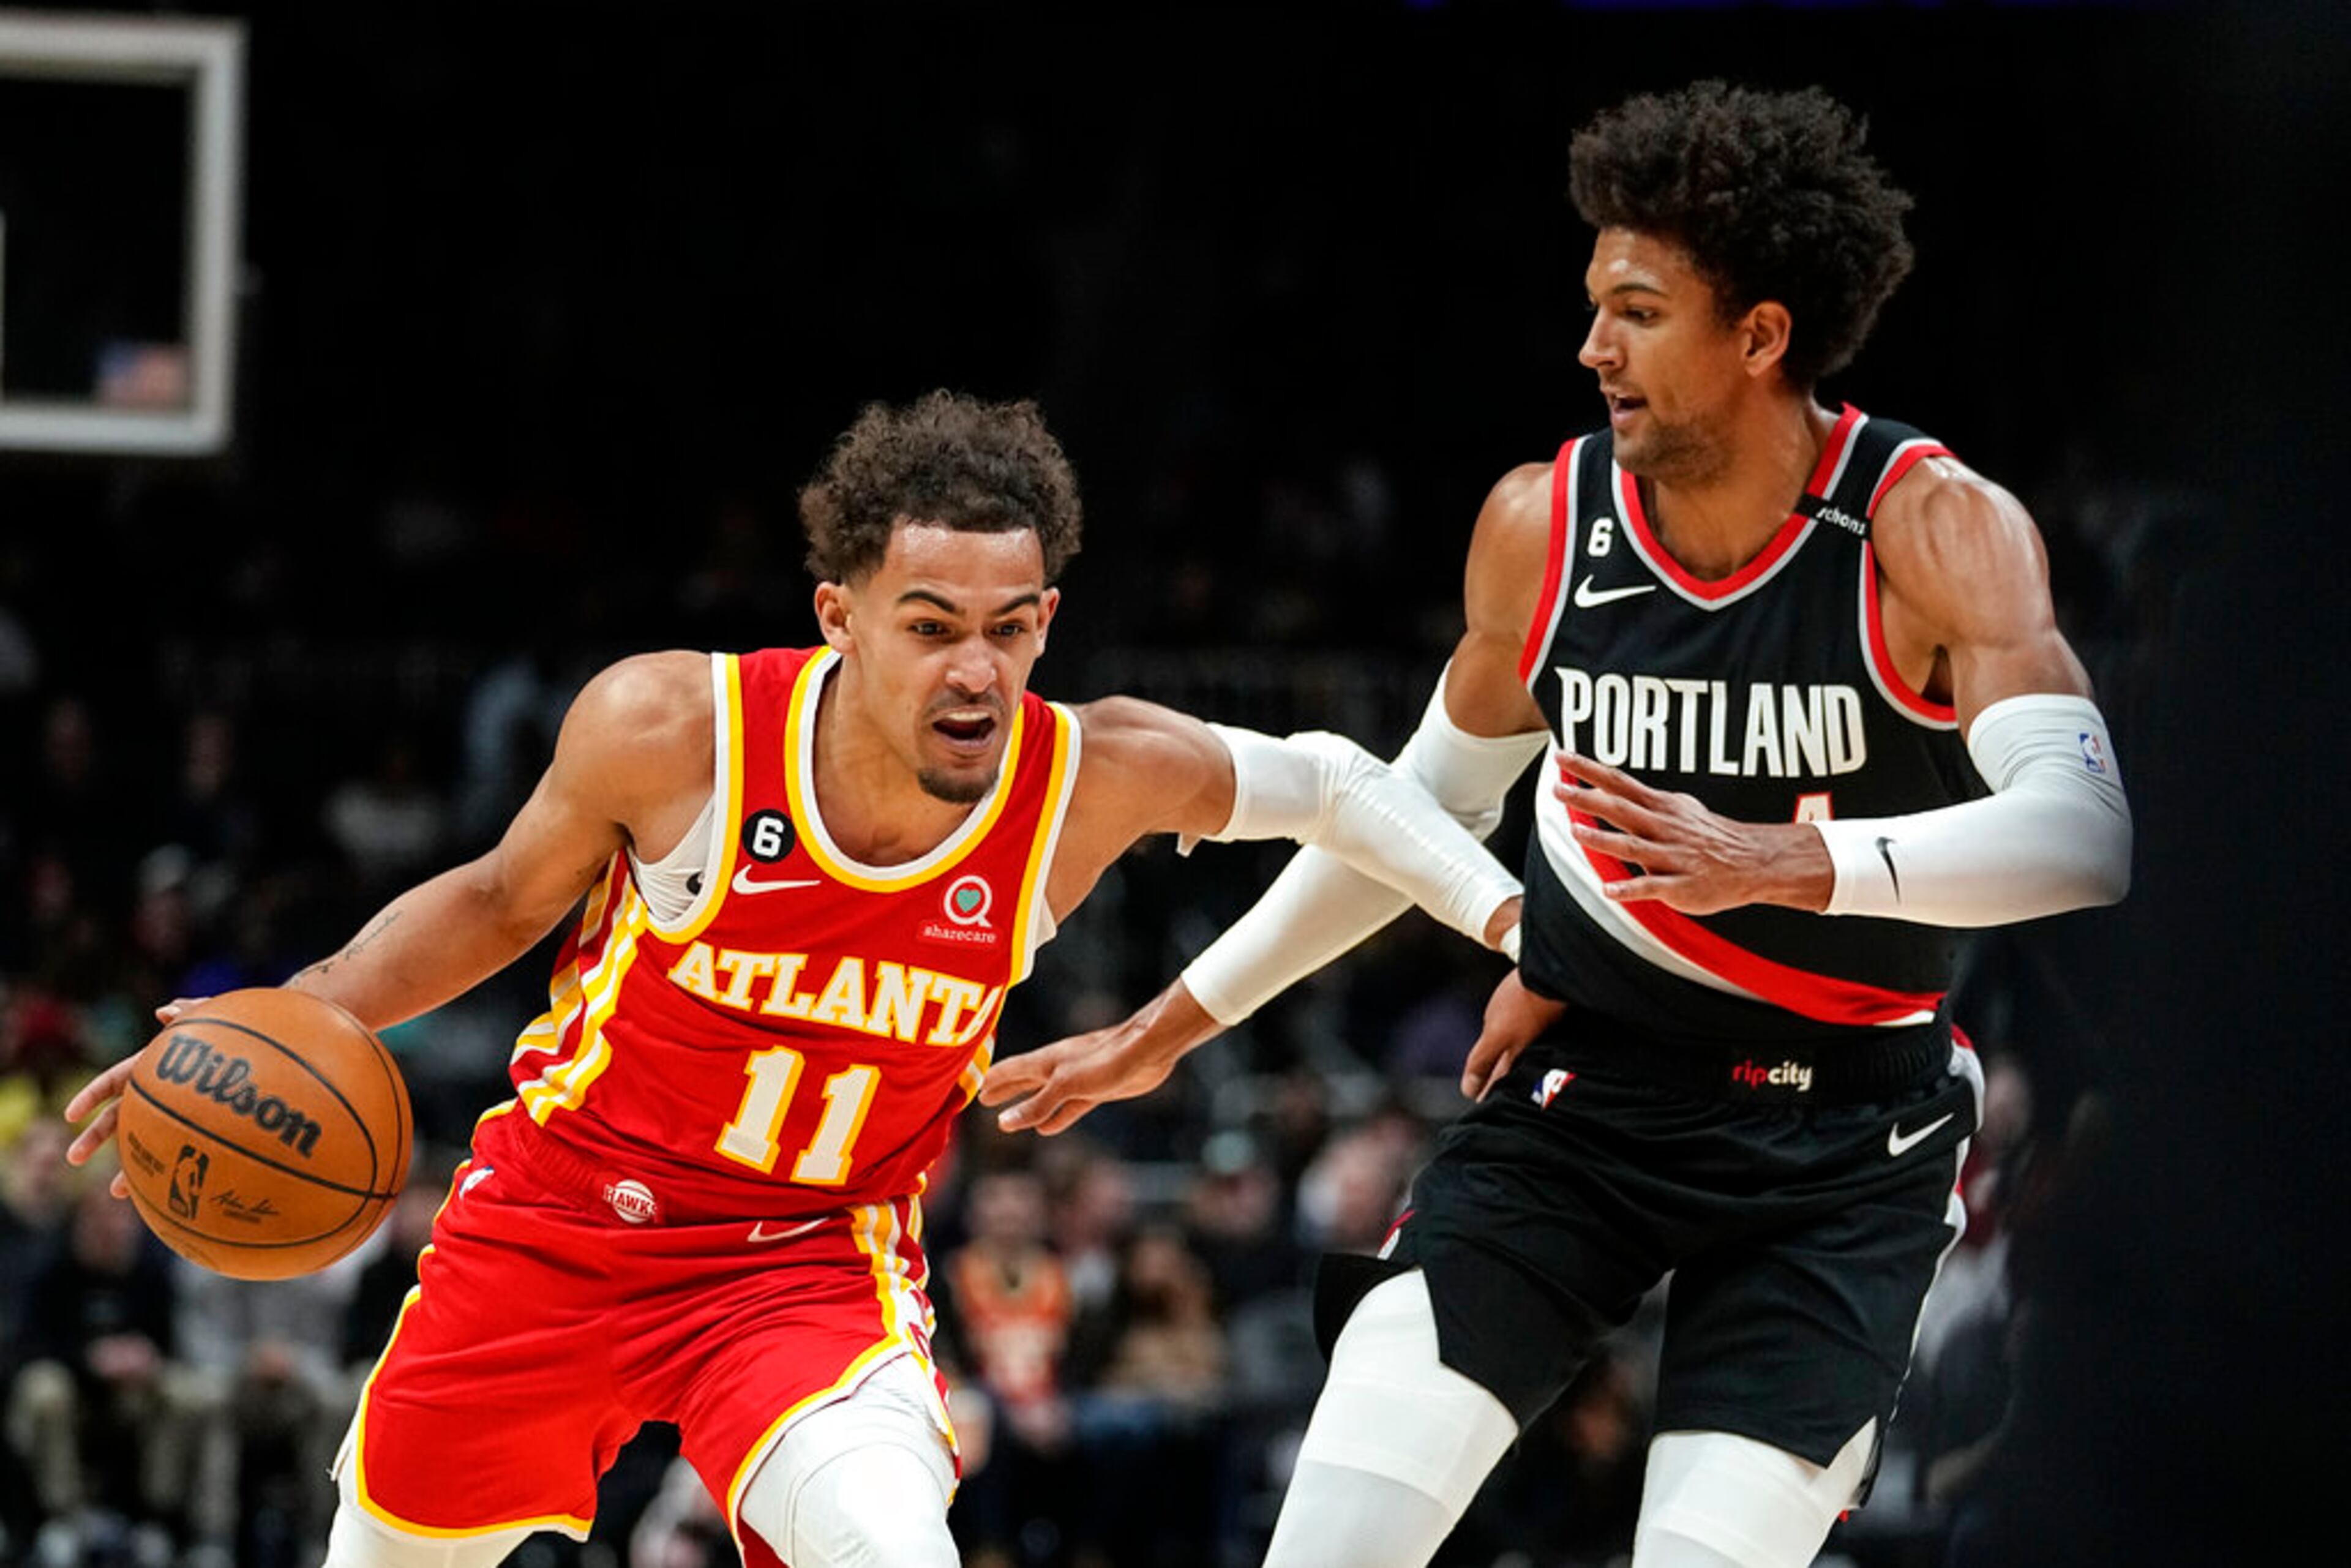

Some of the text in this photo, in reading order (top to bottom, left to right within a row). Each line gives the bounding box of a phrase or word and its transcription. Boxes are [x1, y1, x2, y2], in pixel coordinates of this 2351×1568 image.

[1588, 518, 1613, 557] 6
[1554, 666, 1867, 778] PORTLAND
[752, 816, 784, 858] 6
[923, 924, 996, 943] sharecare
[157, 1035, 321, 1158] Wilson
[1732, 1060, 1813, 1092] ripcity
[714, 1045, 882, 1187] 11
